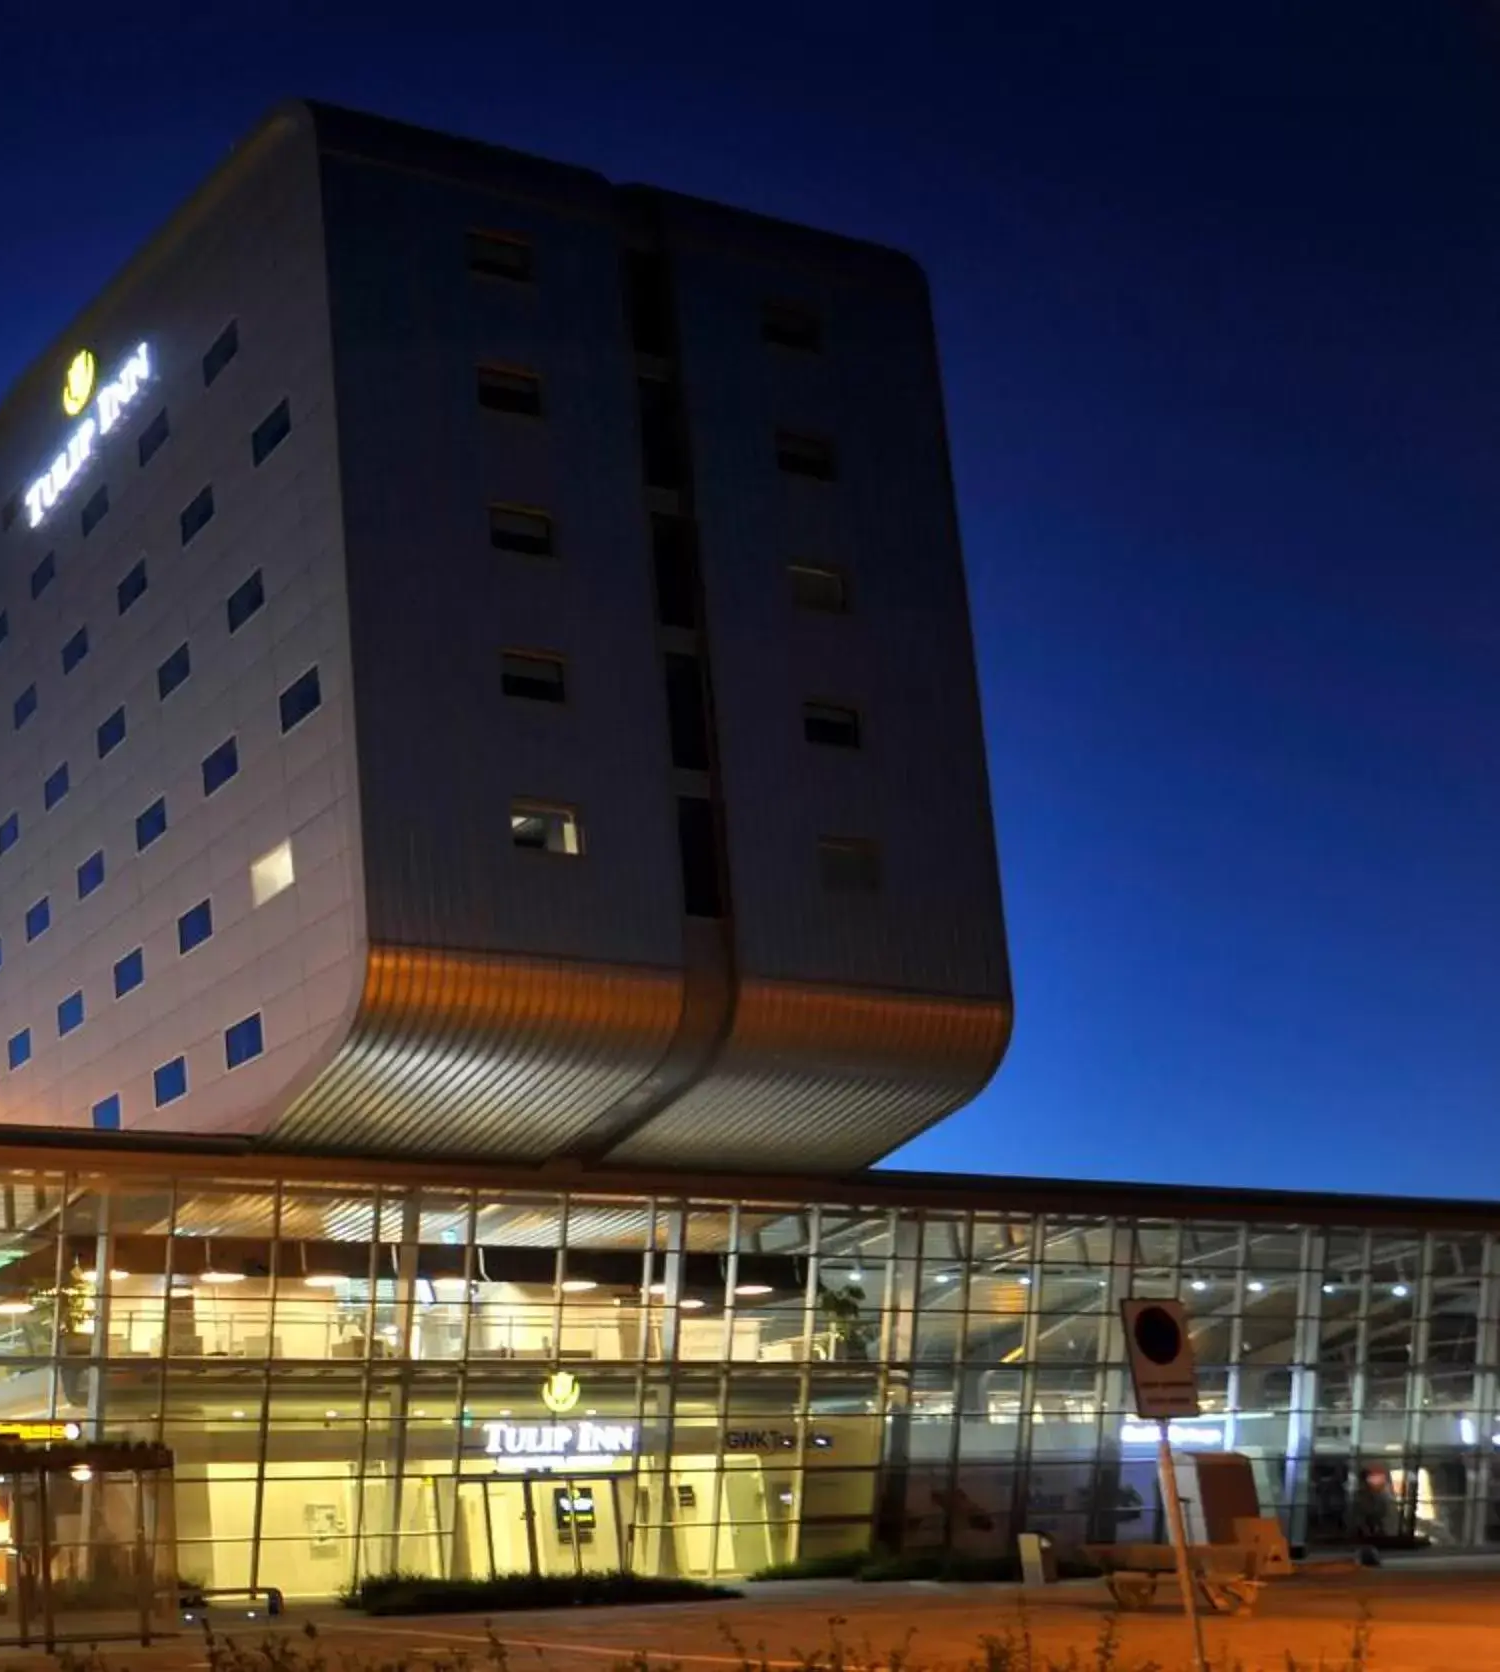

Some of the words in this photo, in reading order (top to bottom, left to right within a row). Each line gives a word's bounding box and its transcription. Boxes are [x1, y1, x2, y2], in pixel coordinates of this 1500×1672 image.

[25, 417, 95, 528] TULIP
[97, 342, 149, 435] INN
[483, 1422, 573, 1453] TULIP
[576, 1421, 635, 1453] INN
